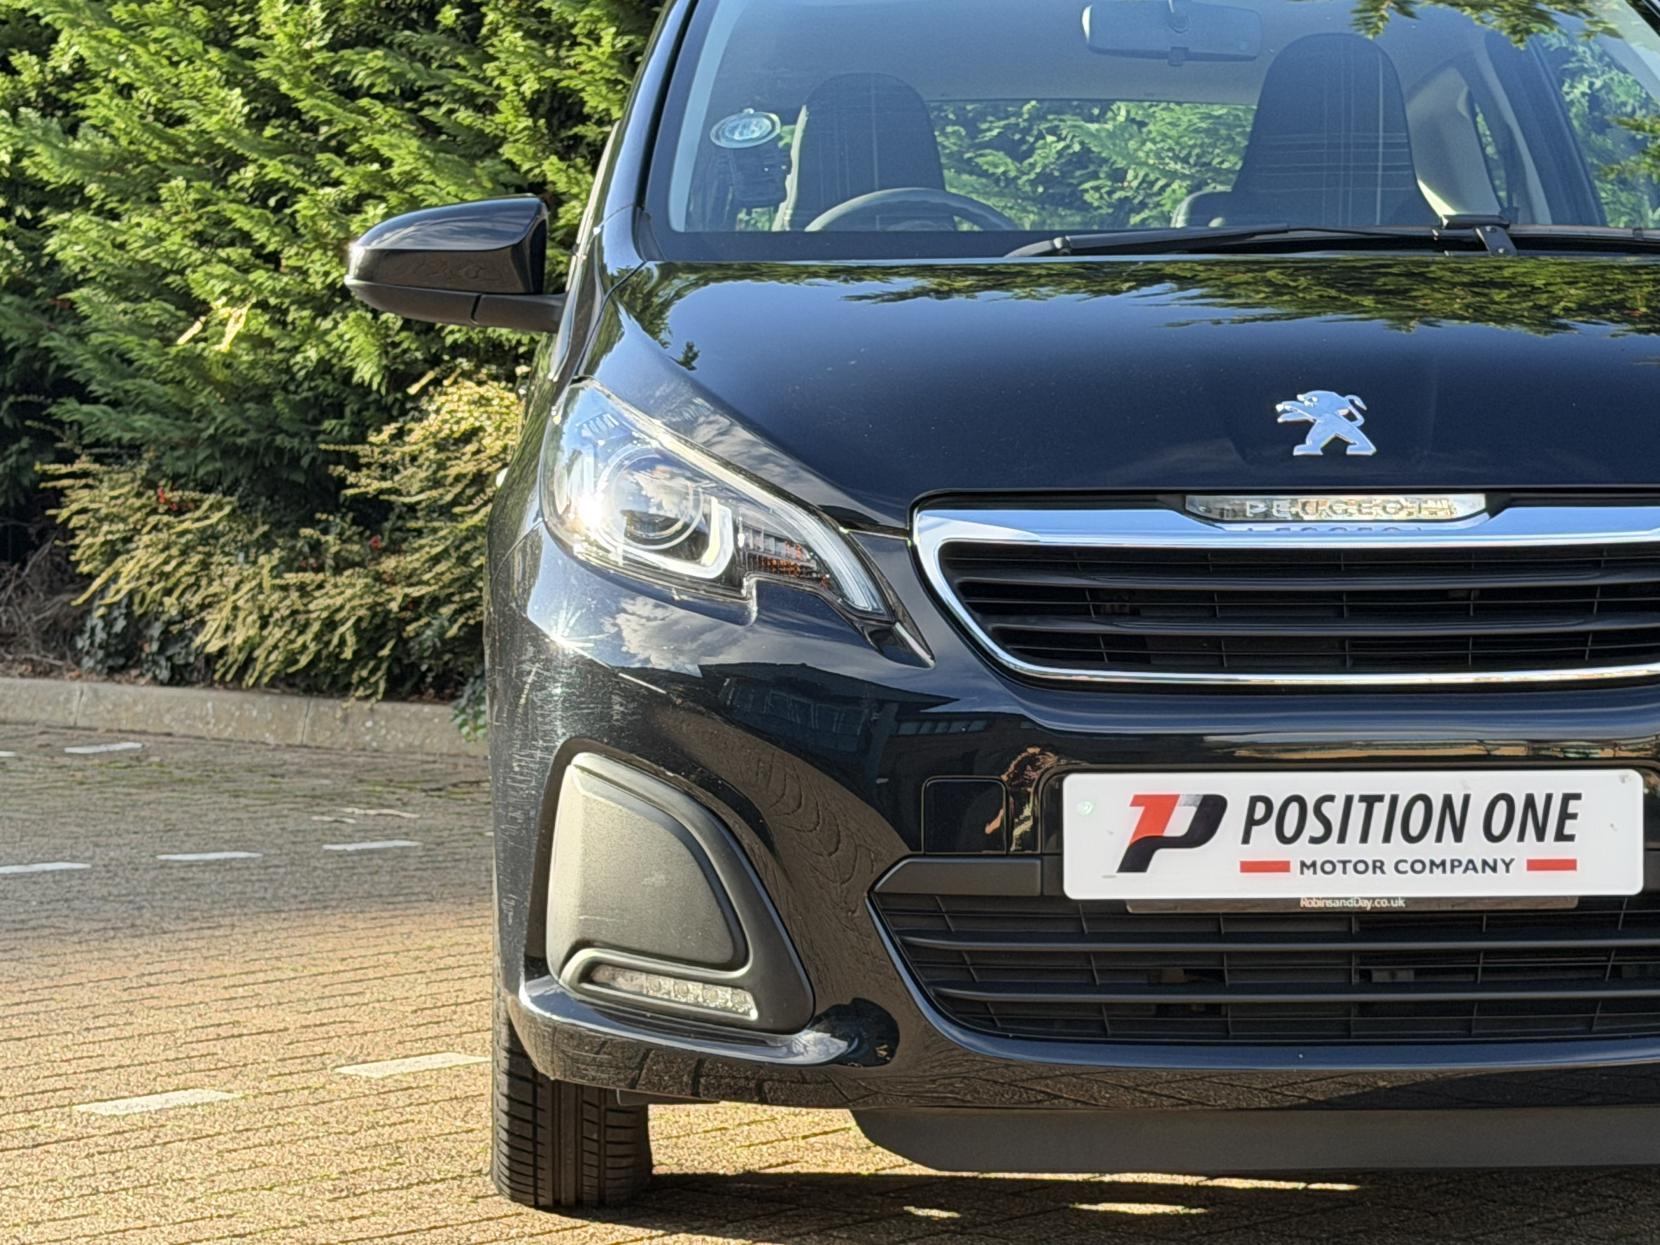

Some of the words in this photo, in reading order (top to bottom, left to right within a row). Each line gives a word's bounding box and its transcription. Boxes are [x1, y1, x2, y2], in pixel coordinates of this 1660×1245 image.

[1241, 793, 1471, 845] POSITION
[1482, 792, 1582, 844] ONE
[1299, 859, 1387, 876] MOTOR
[1393, 858, 1515, 875] COMPANY
